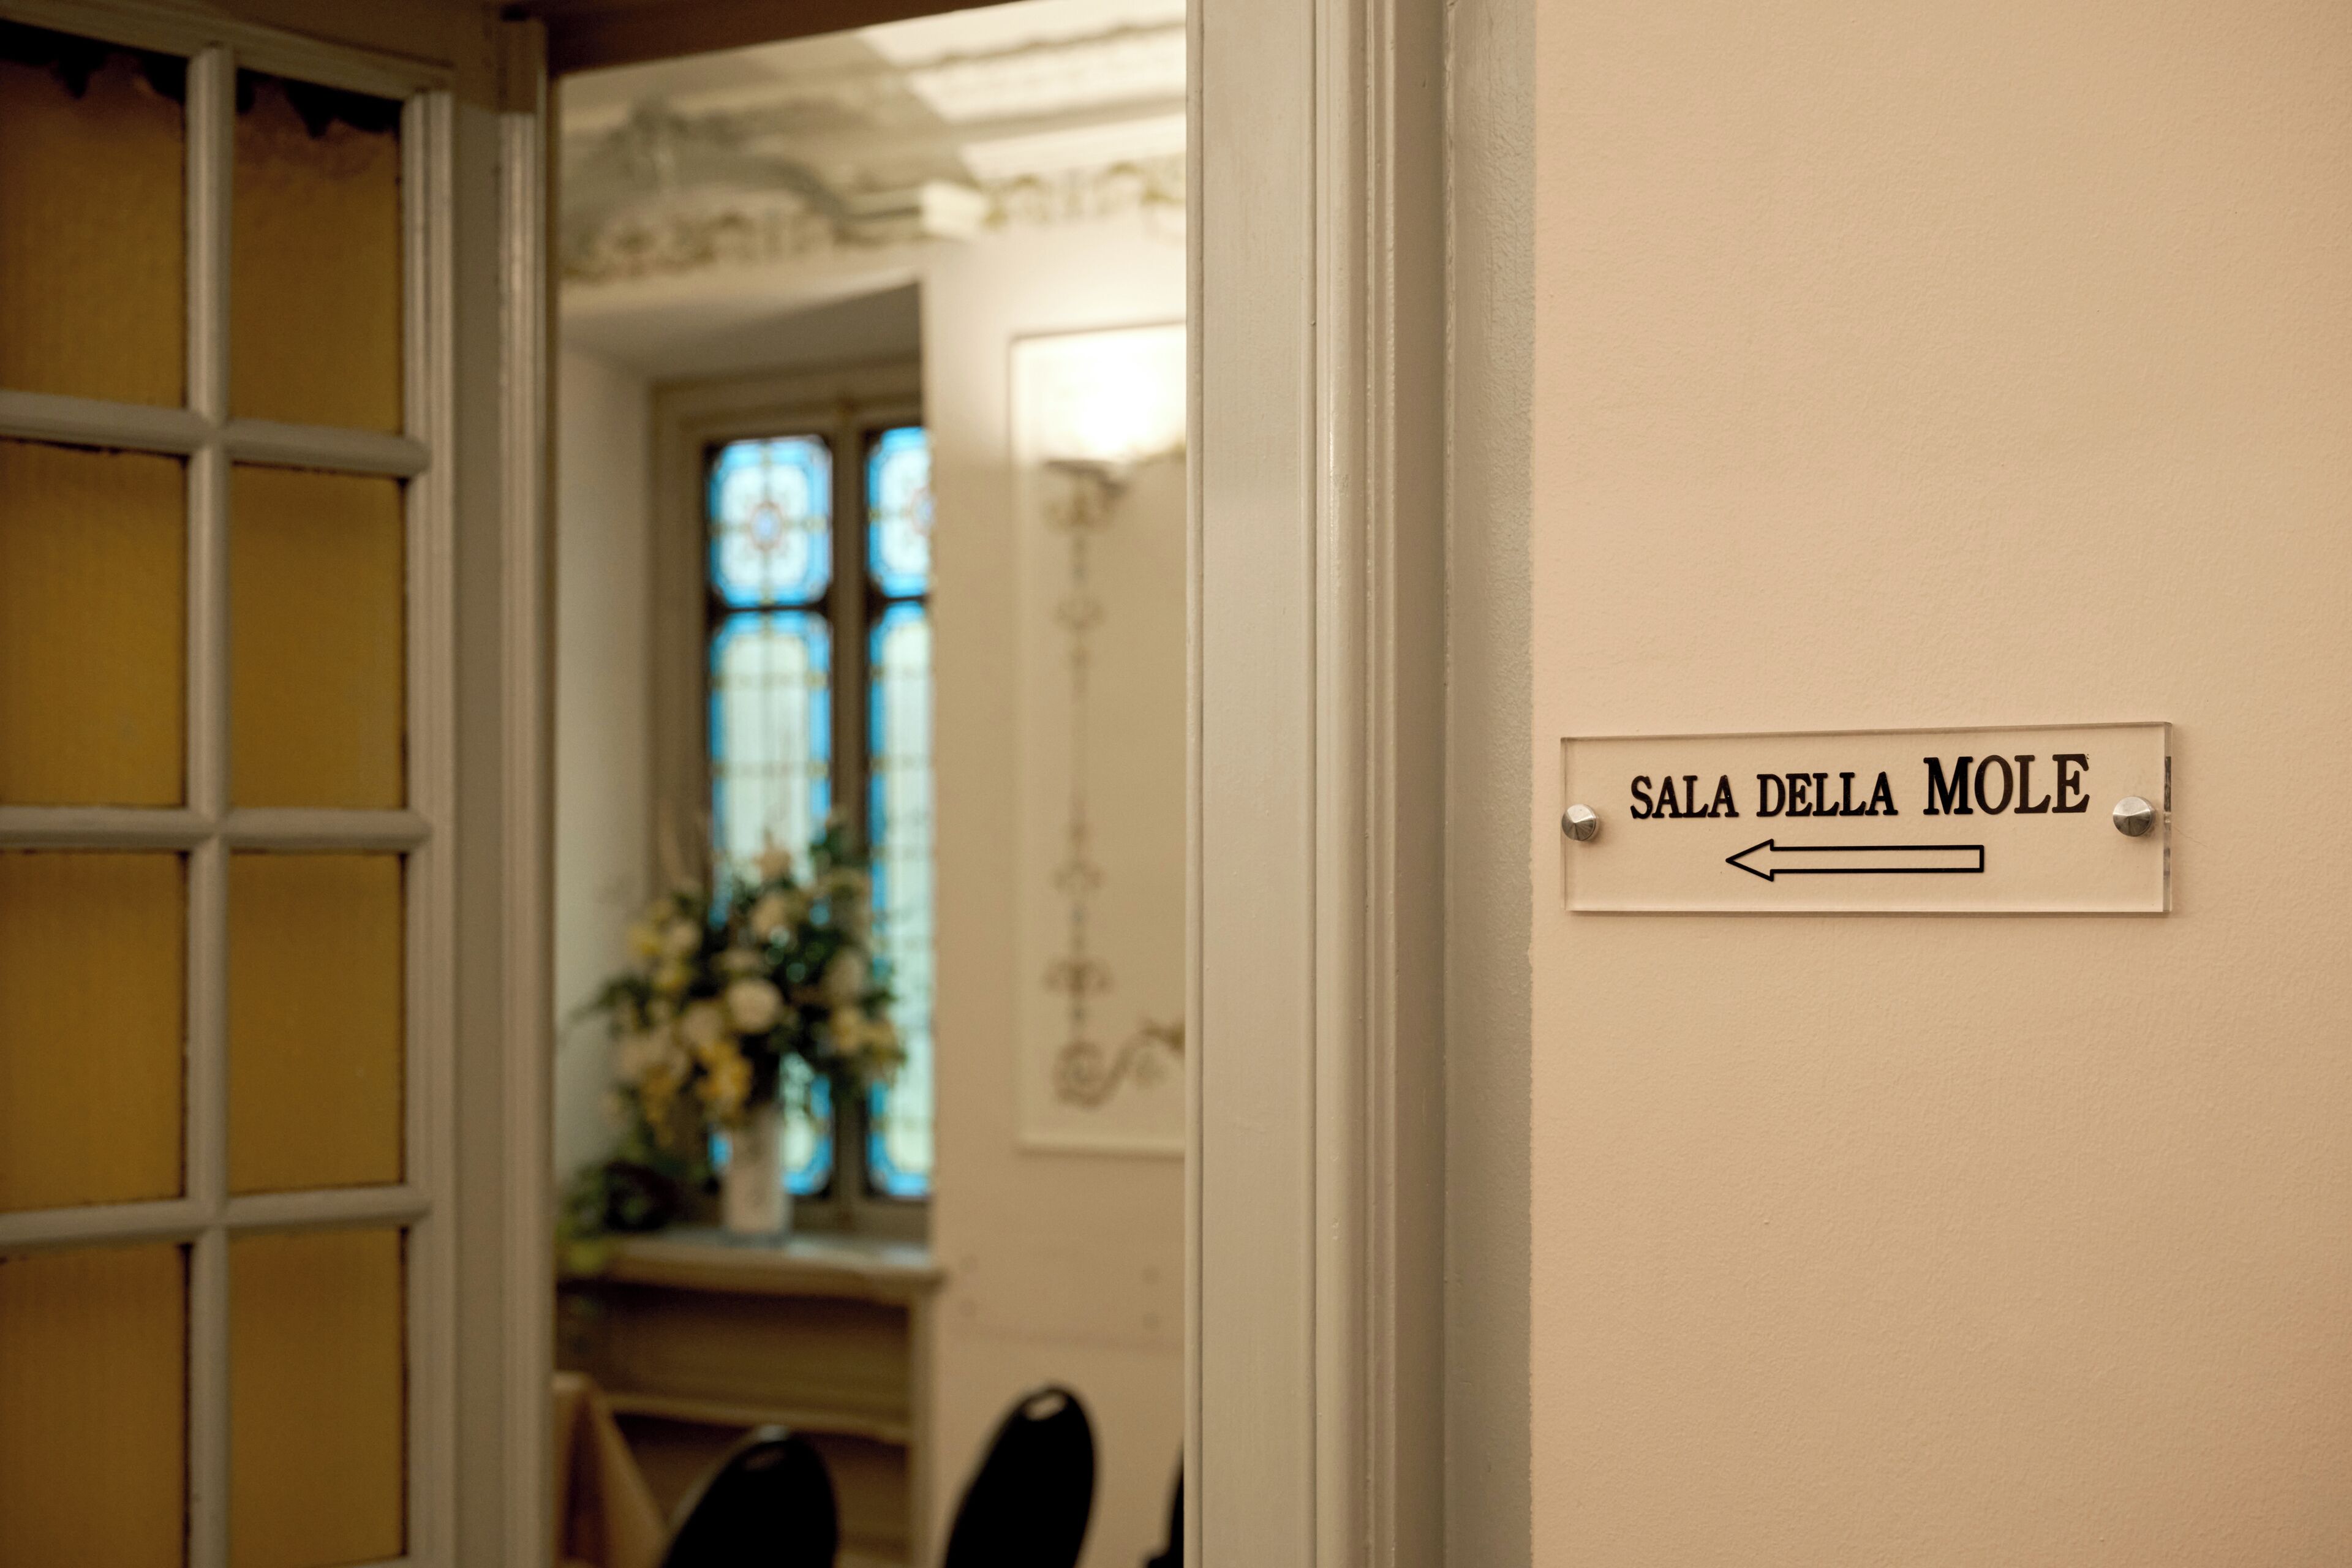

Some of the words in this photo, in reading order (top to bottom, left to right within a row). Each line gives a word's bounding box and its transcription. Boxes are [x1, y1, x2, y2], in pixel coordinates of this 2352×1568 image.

[1630, 774, 1740, 820] SALA
[1756, 771, 1899, 818] DELLA
[1923, 753, 2090, 816] MOLE
